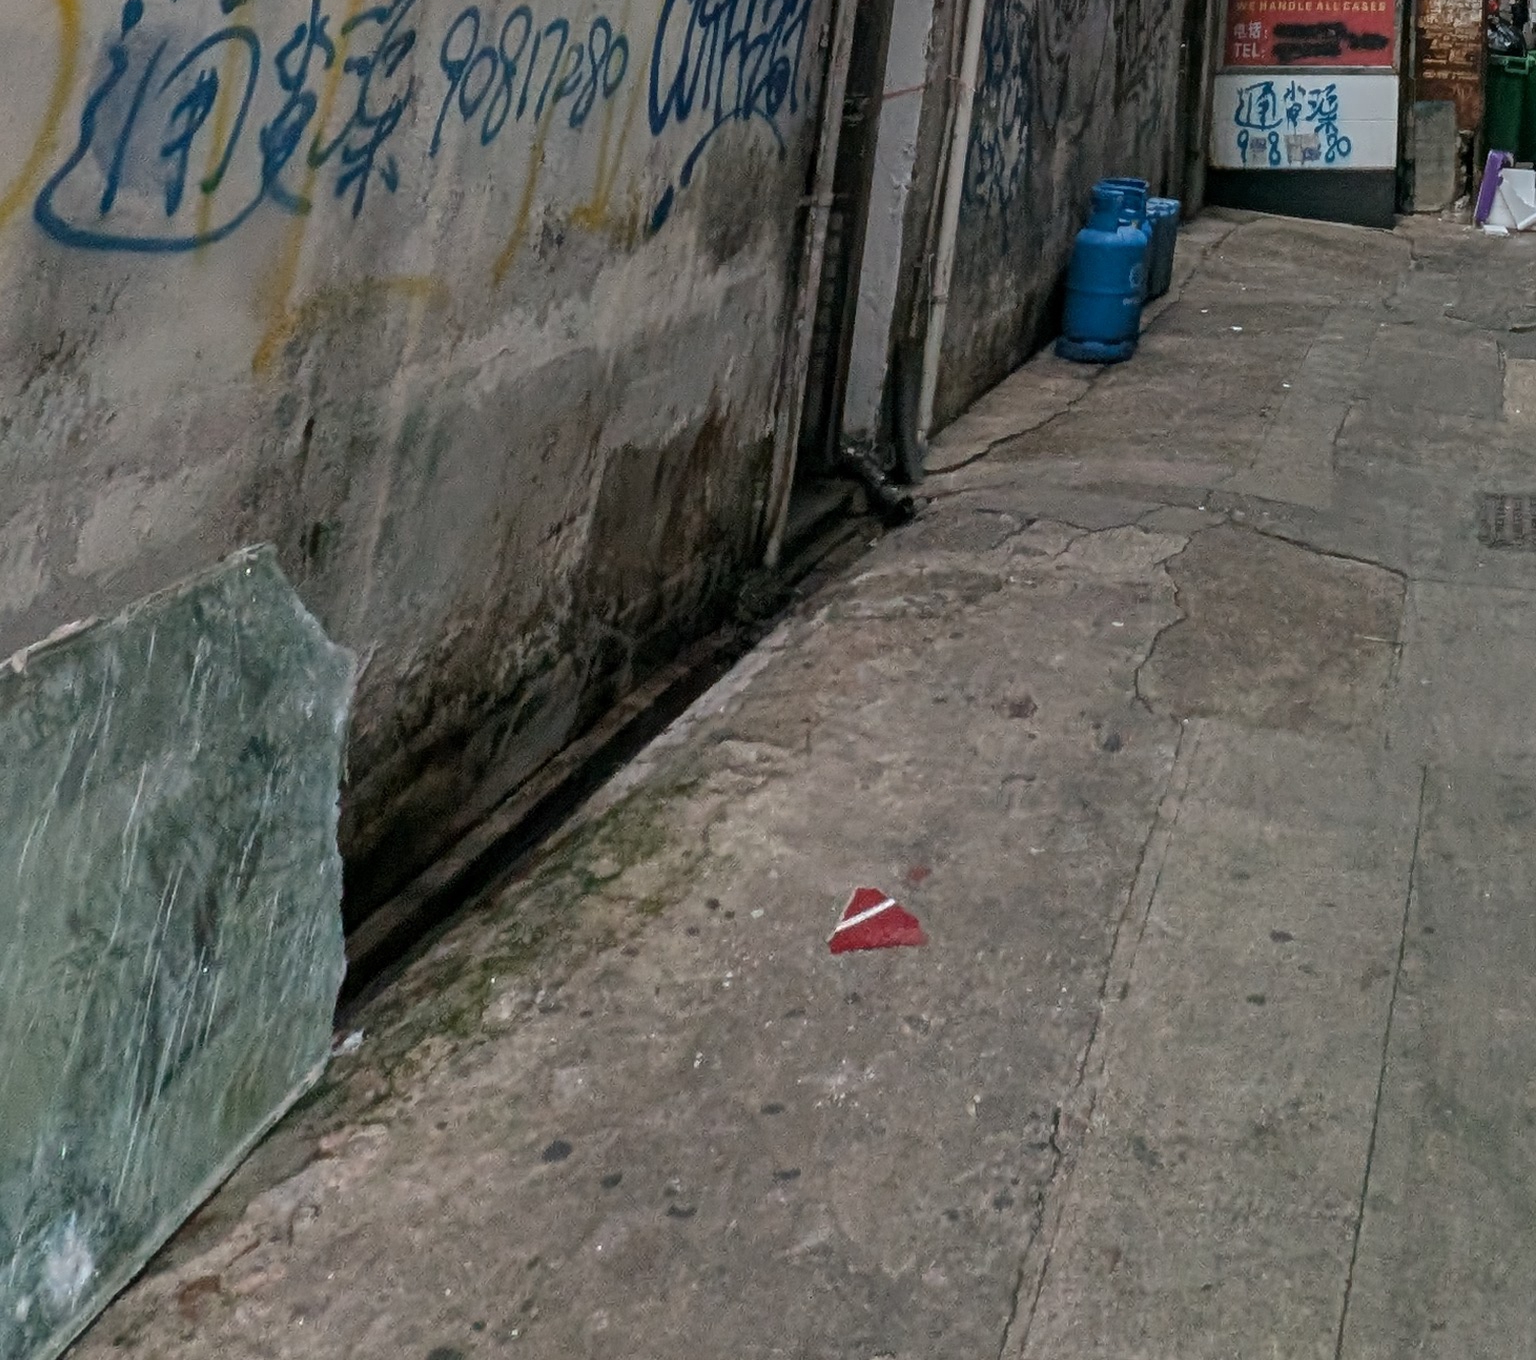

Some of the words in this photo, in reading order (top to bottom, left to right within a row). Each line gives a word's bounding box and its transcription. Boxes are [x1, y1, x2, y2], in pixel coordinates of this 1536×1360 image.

[1259, 1, 1312, 12] HANDLE
[1316, 1, 1339, 12] ALL
[1343, 1, 1386, 12] CASES
